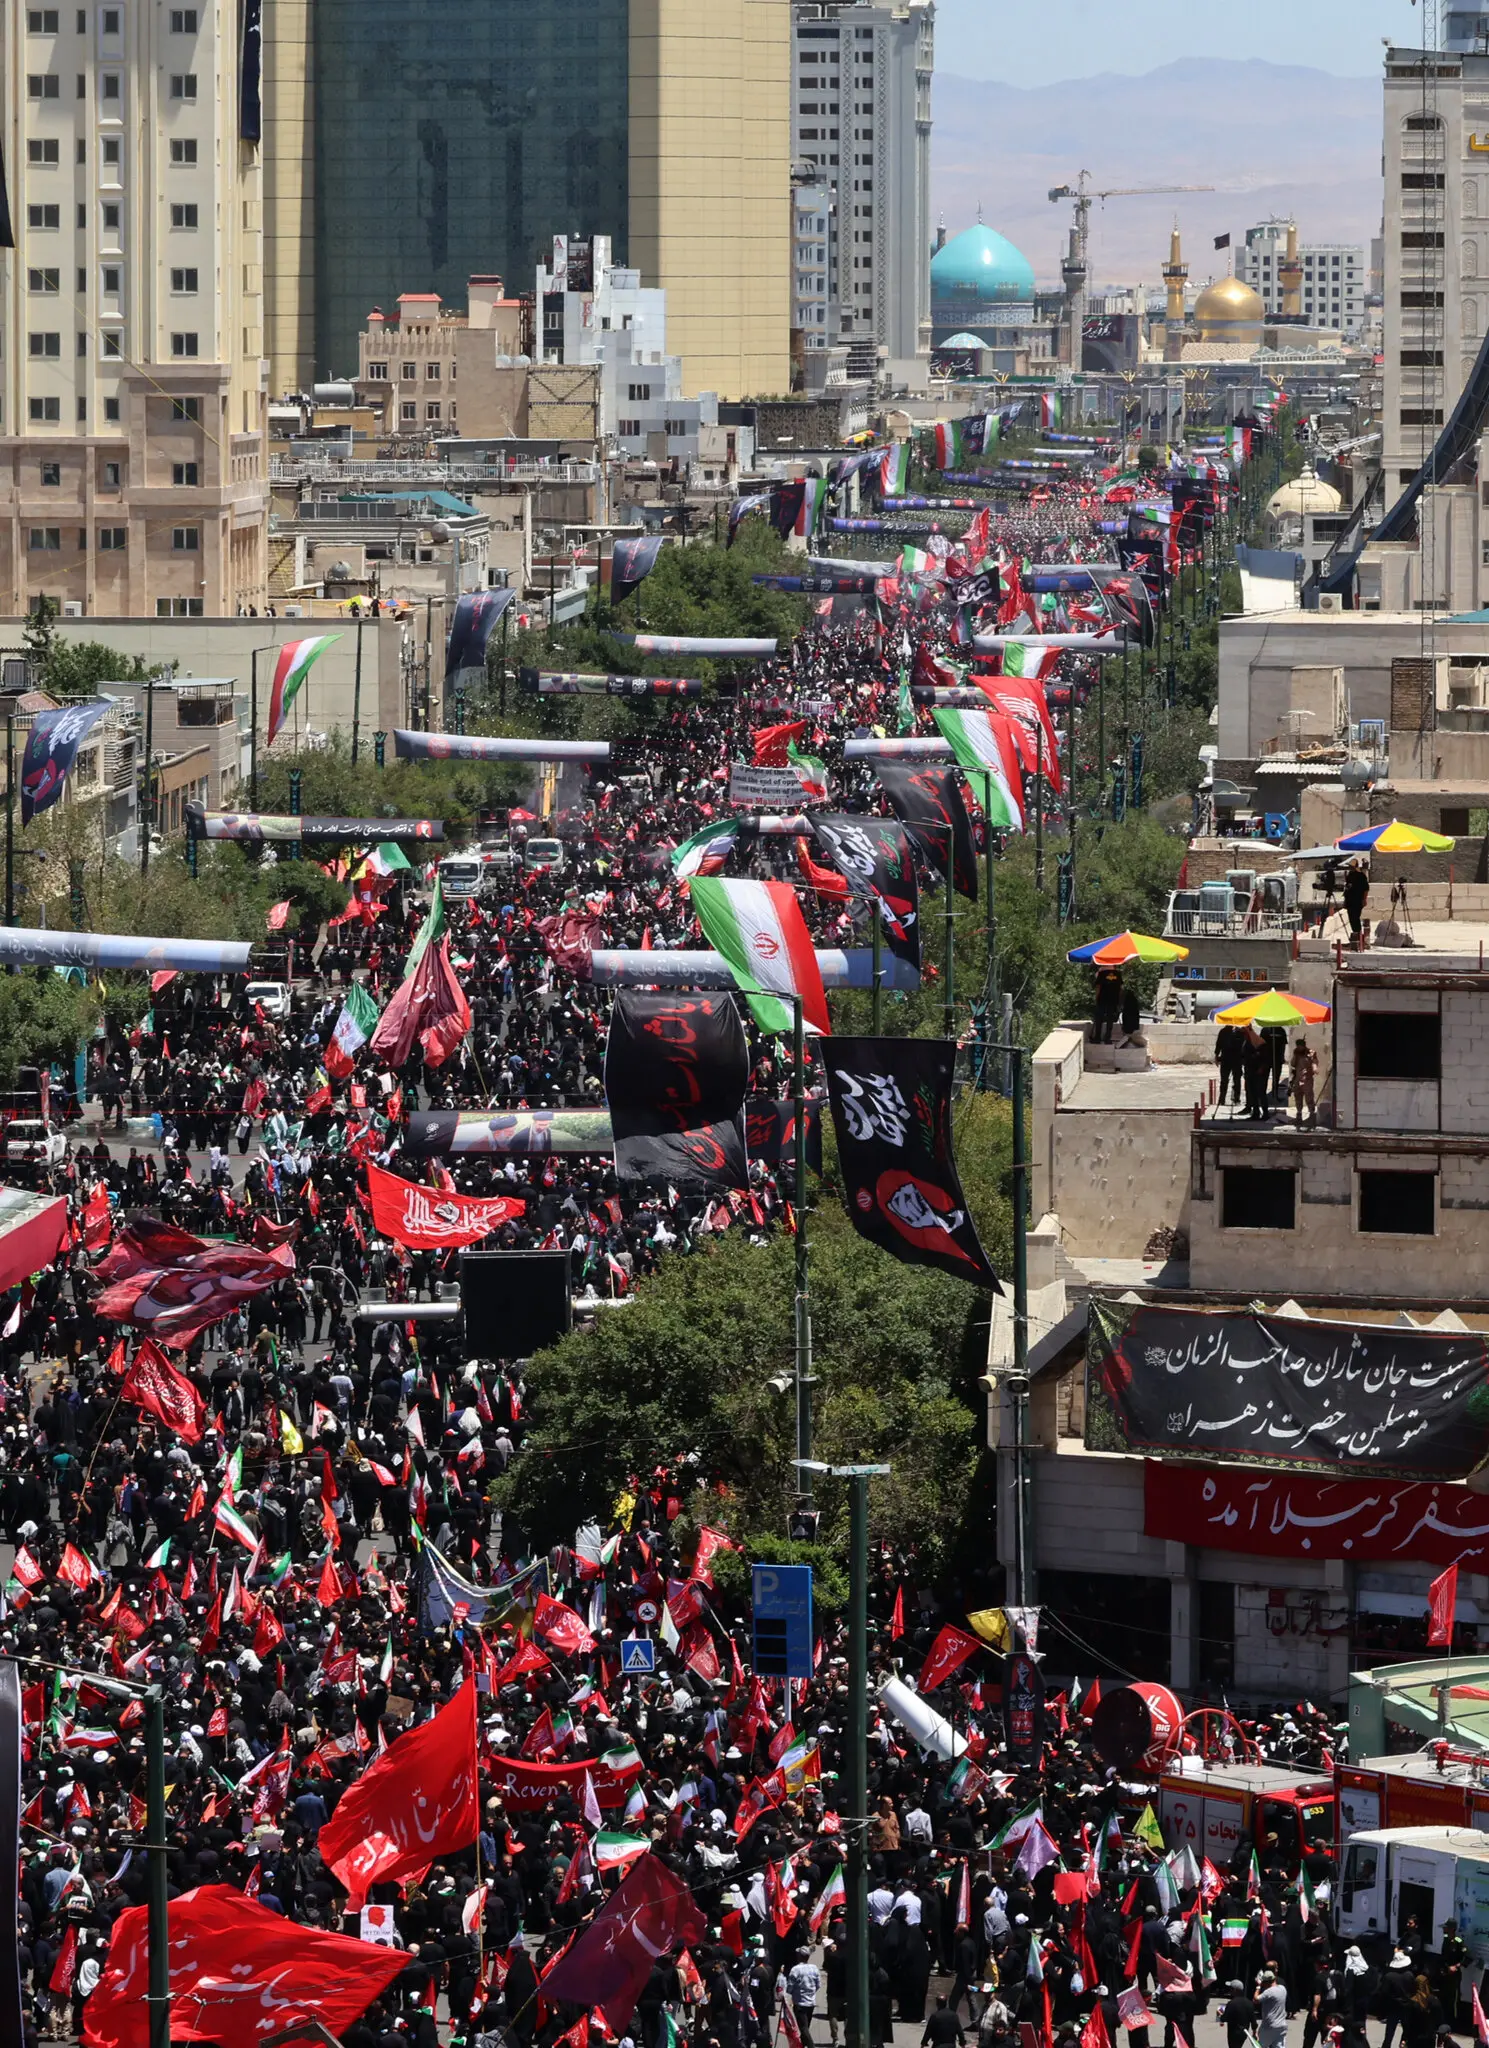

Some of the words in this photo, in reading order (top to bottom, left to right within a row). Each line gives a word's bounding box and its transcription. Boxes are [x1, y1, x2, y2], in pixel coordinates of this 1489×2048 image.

[380, 823, 408, 836] انقلاب
[1302, 1332, 1368, 1388] نثاران
[1363, 1361, 1407, 1398] جان
[1184, 1400, 1274, 1438] زهرا
[1268, 1399, 1347, 1450] حضرت
[1202, 1477, 1273, 1531] آمده
[755, 1570, 779, 1605] P
[1155, 1723, 1171, 1732] BIG
[505, 1772, 574, 1798] Revene
